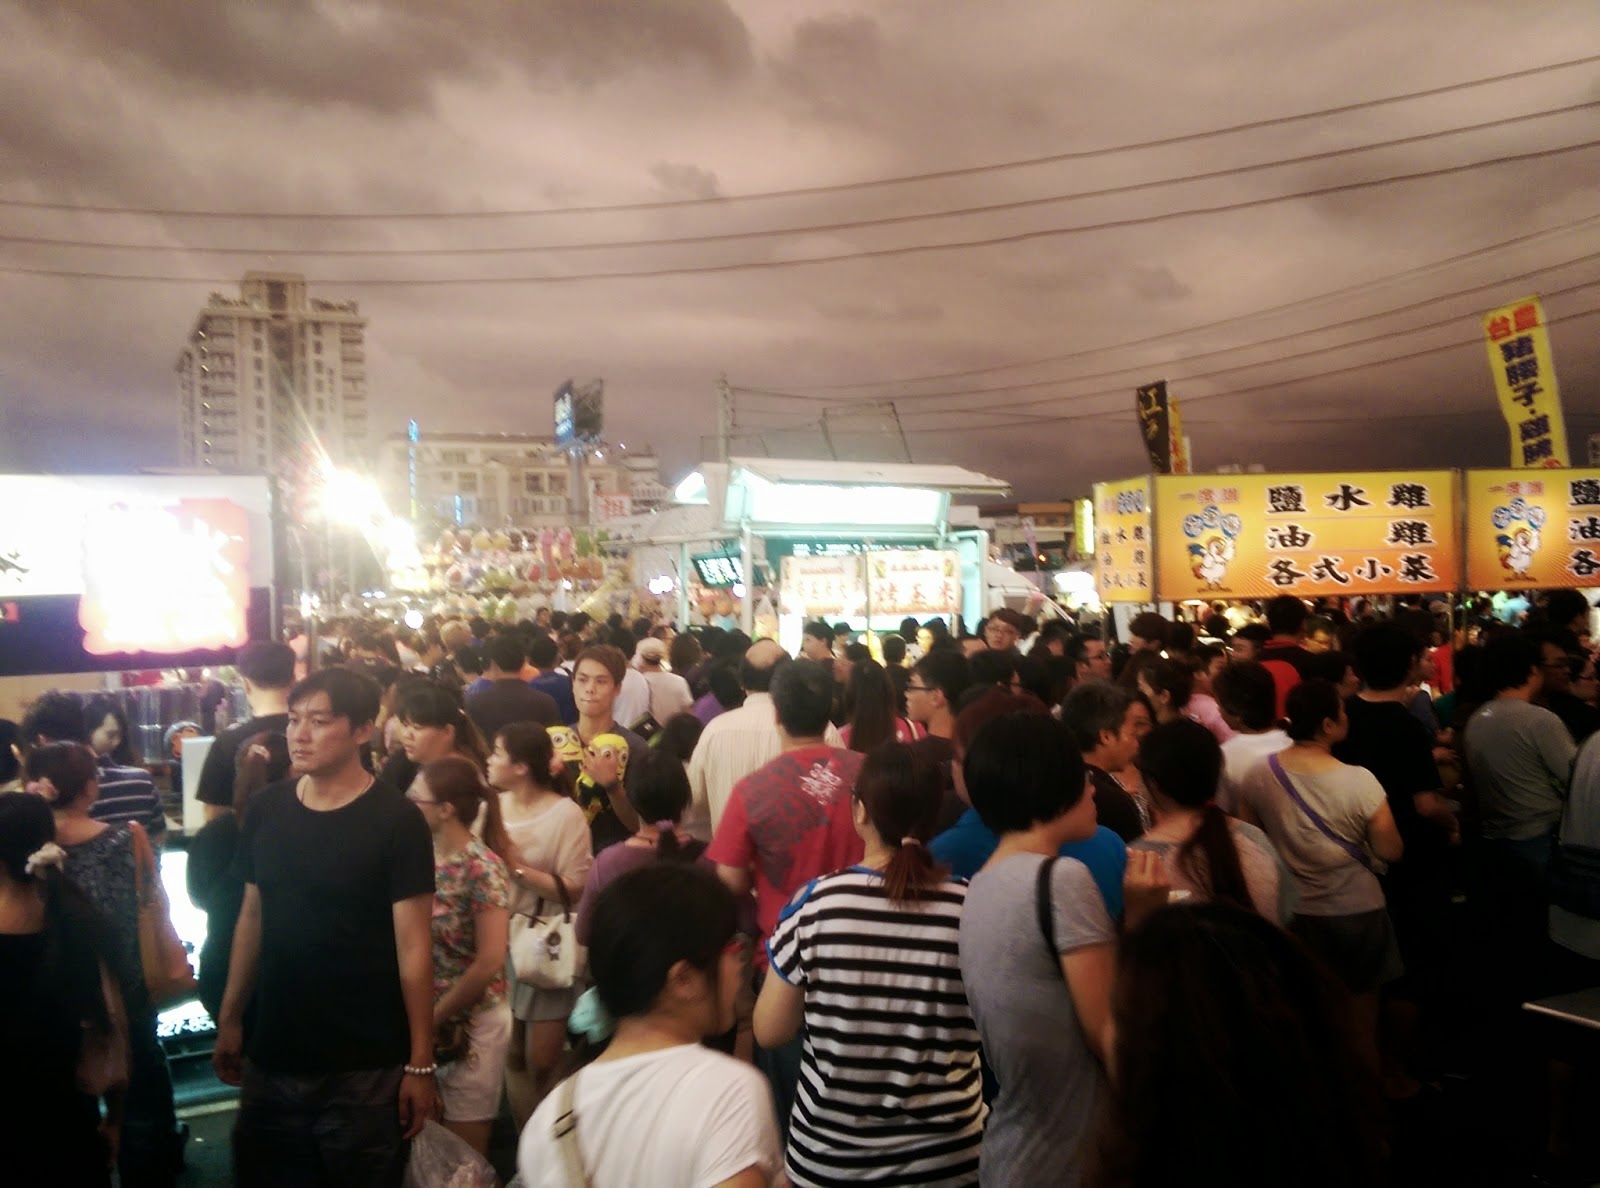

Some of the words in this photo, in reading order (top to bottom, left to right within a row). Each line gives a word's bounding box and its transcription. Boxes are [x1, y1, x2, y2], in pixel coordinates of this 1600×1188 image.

[1267, 484, 1431, 512] 鹽水雞
[1267, 521, 1433, 548] 油雞
[1268, 554, 1435, 584] 各式小菜
